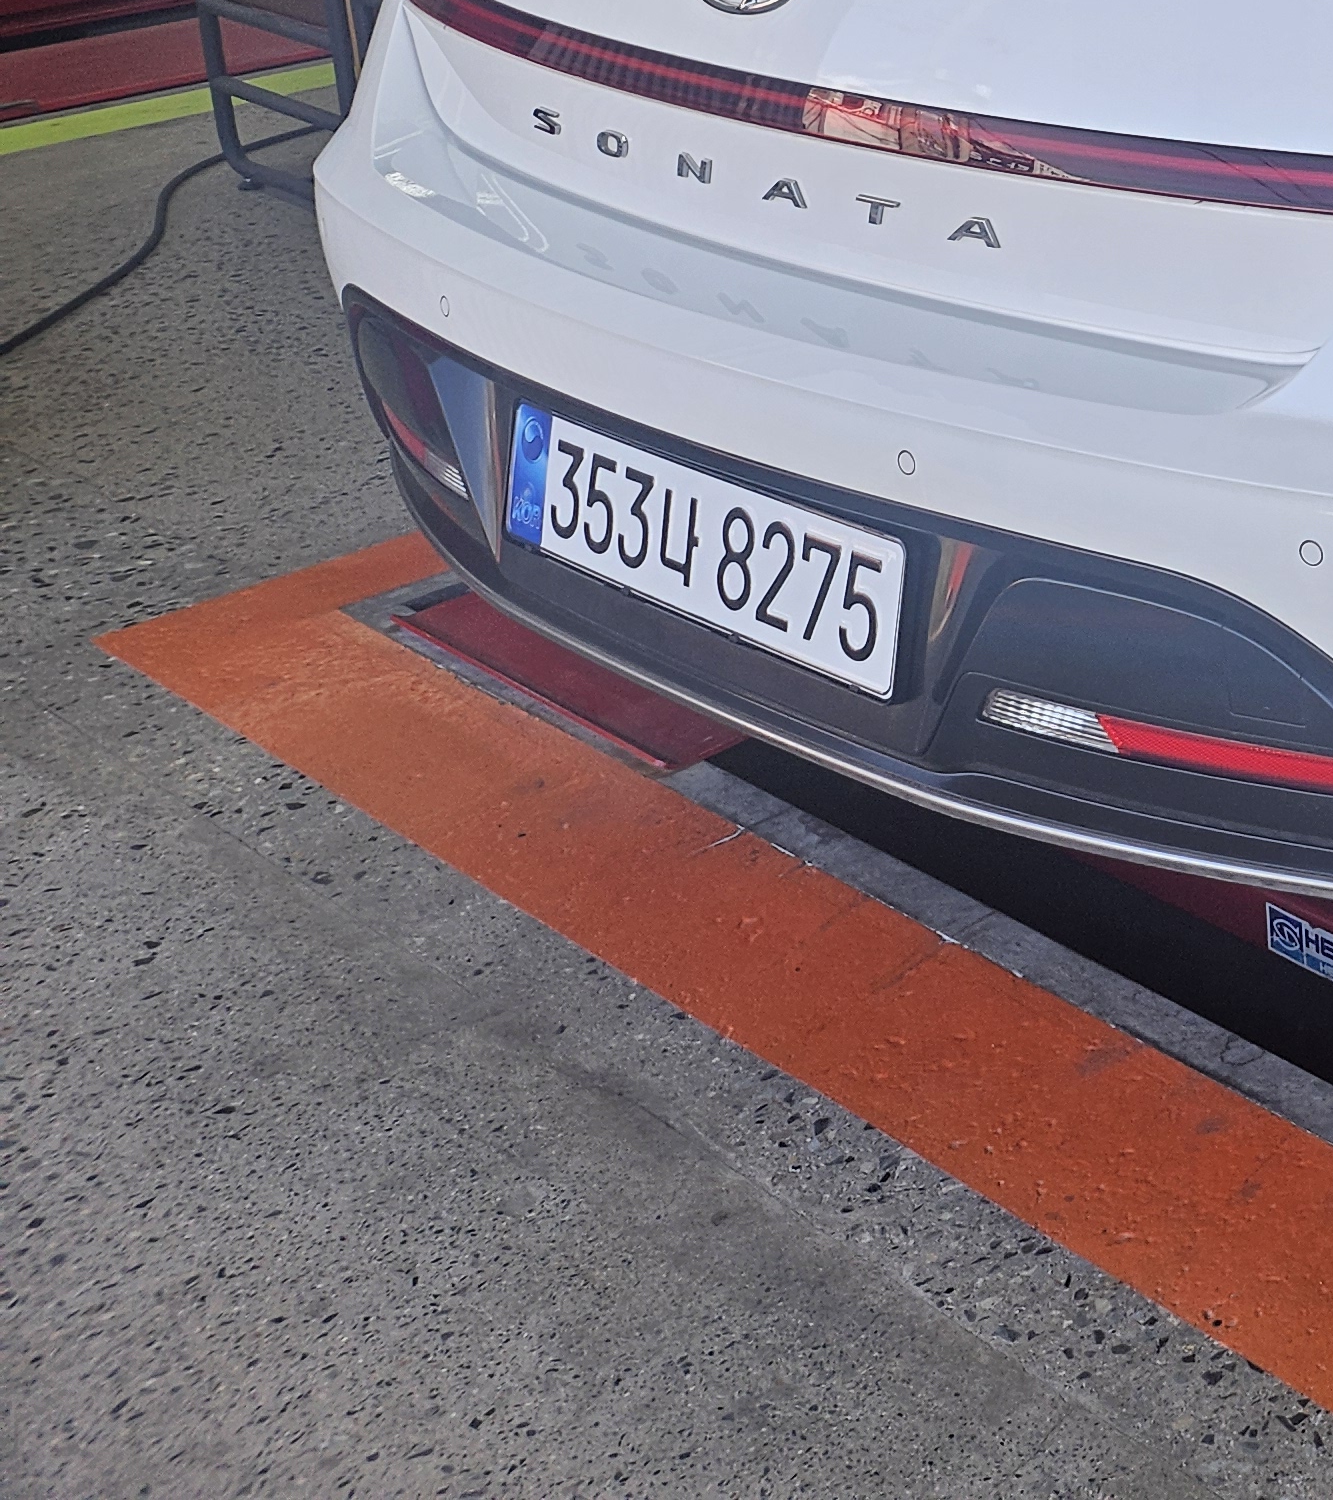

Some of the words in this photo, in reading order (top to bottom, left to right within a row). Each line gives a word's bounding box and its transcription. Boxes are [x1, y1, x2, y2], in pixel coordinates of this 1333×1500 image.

[531, 105, 1002, 249] SONATA
[549, 438, 700, 588] 353나
[716, 505, 884, 662] 8275
